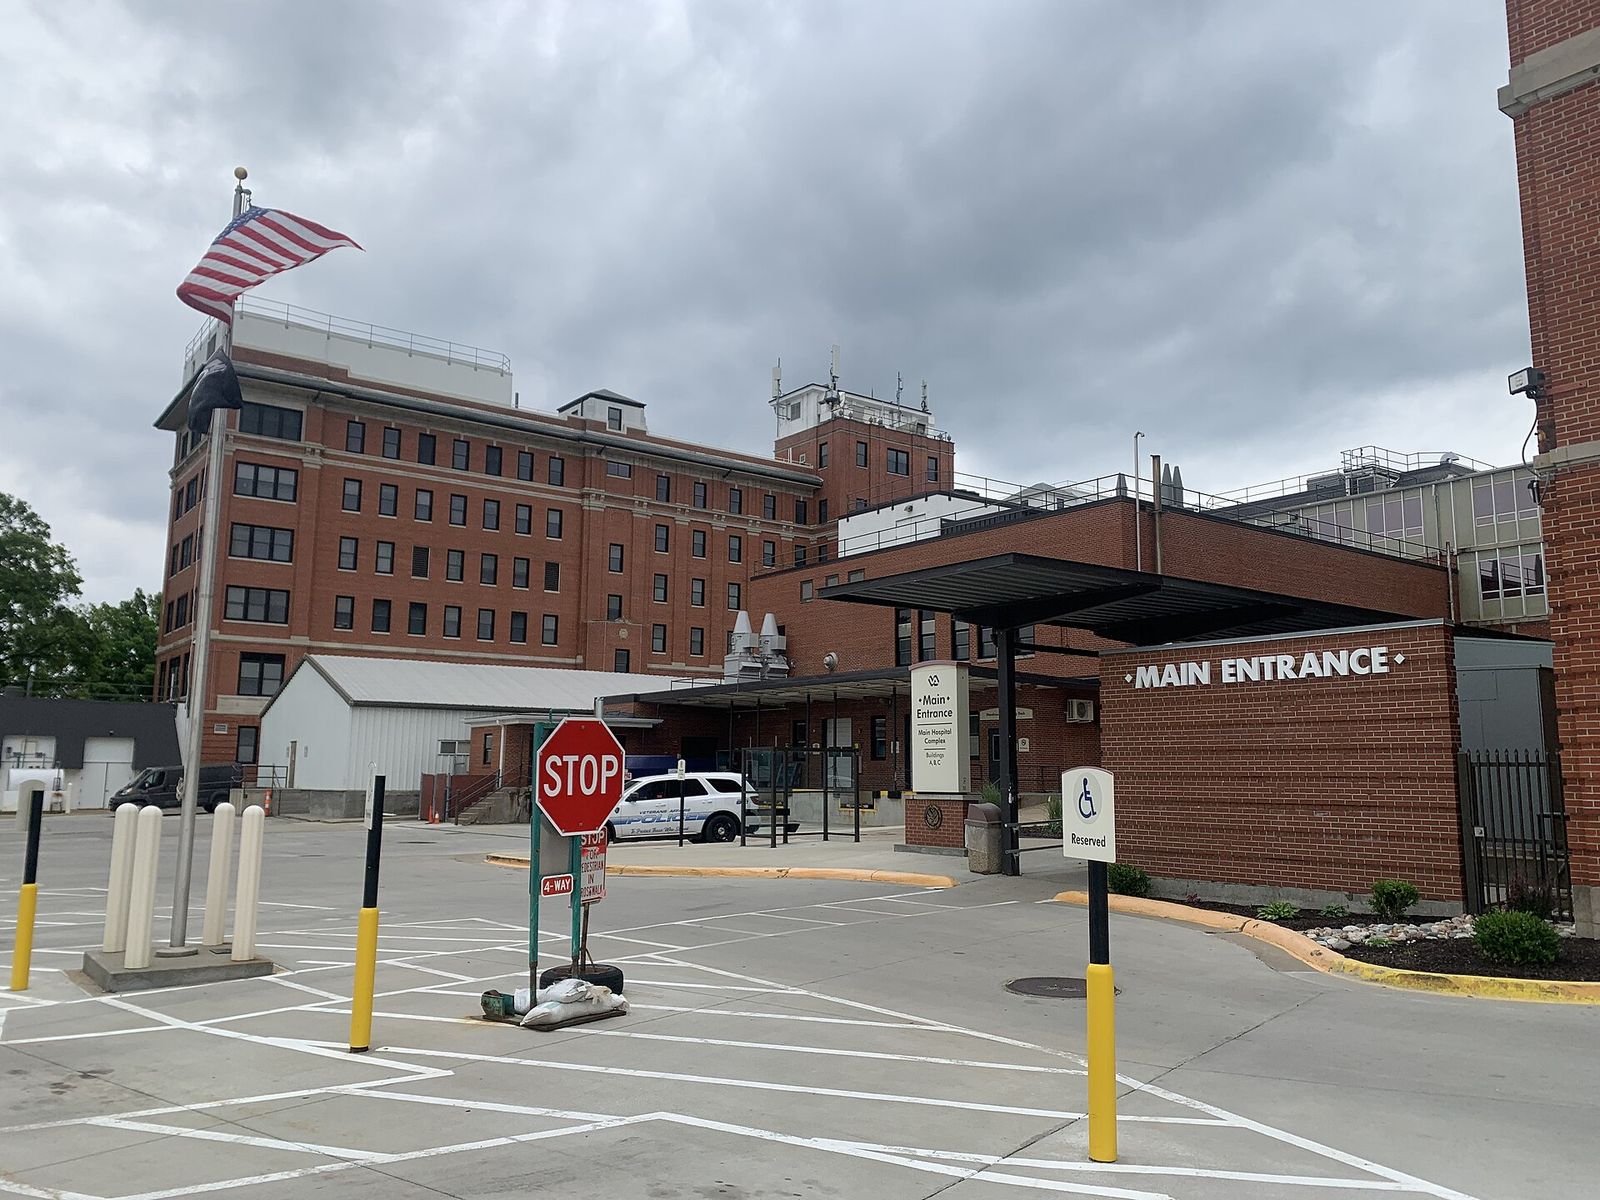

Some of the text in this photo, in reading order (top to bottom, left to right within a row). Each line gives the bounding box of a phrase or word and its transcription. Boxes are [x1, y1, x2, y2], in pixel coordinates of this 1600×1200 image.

[1135, 646, 1390, 689] MAIN ENTRANCE
[922, 694, 946, 706] Main
[917, 709, 953, 719] Entrance
[931, 728, 952, 737] Hospital
[924, 737, 946, 745] Complex
[926, 752, 945, 760] Buildings
[543, 754, 619, 798] STOP
[627, 813, 699, 825] POLICE
[581, 831, 605, 846] STOP
[1071, 832, 1106, 848] Reserved
[581, 860, 604, 873] EDESTRIAN
[587, 873, 595, 885] IN
[543, 878, 571, 893] 4-WAY
